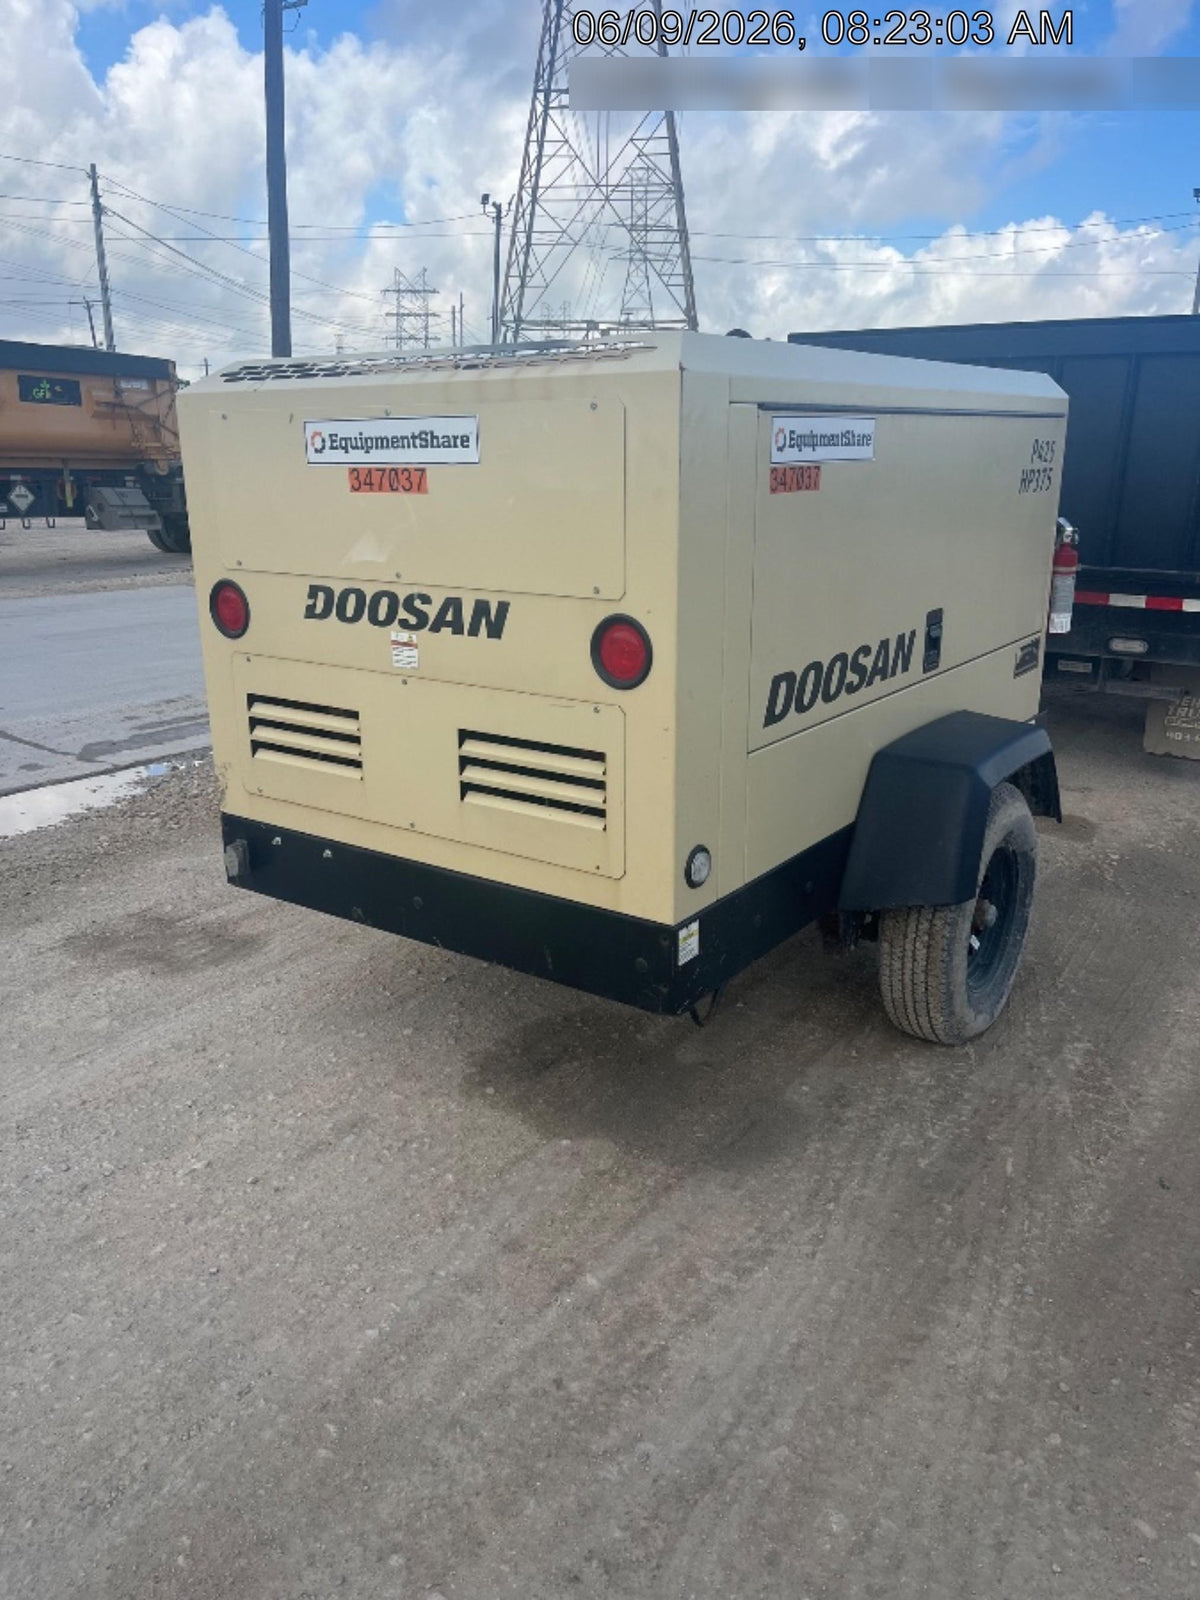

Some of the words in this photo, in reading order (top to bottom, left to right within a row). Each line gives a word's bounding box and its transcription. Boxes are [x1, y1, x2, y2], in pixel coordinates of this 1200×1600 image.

[328, 430, 470, 453] EquipmentShare
[788, 429, 873, 452] EquipmentShare
[350, 467, 427, 492] 347037
[770, 466, 821, 492] 347037
[1018, 467, 1053, 494] HP375
[304, 584, 510, 640] DOOSAN
[763, 629, 916, 728] DOOSAN
